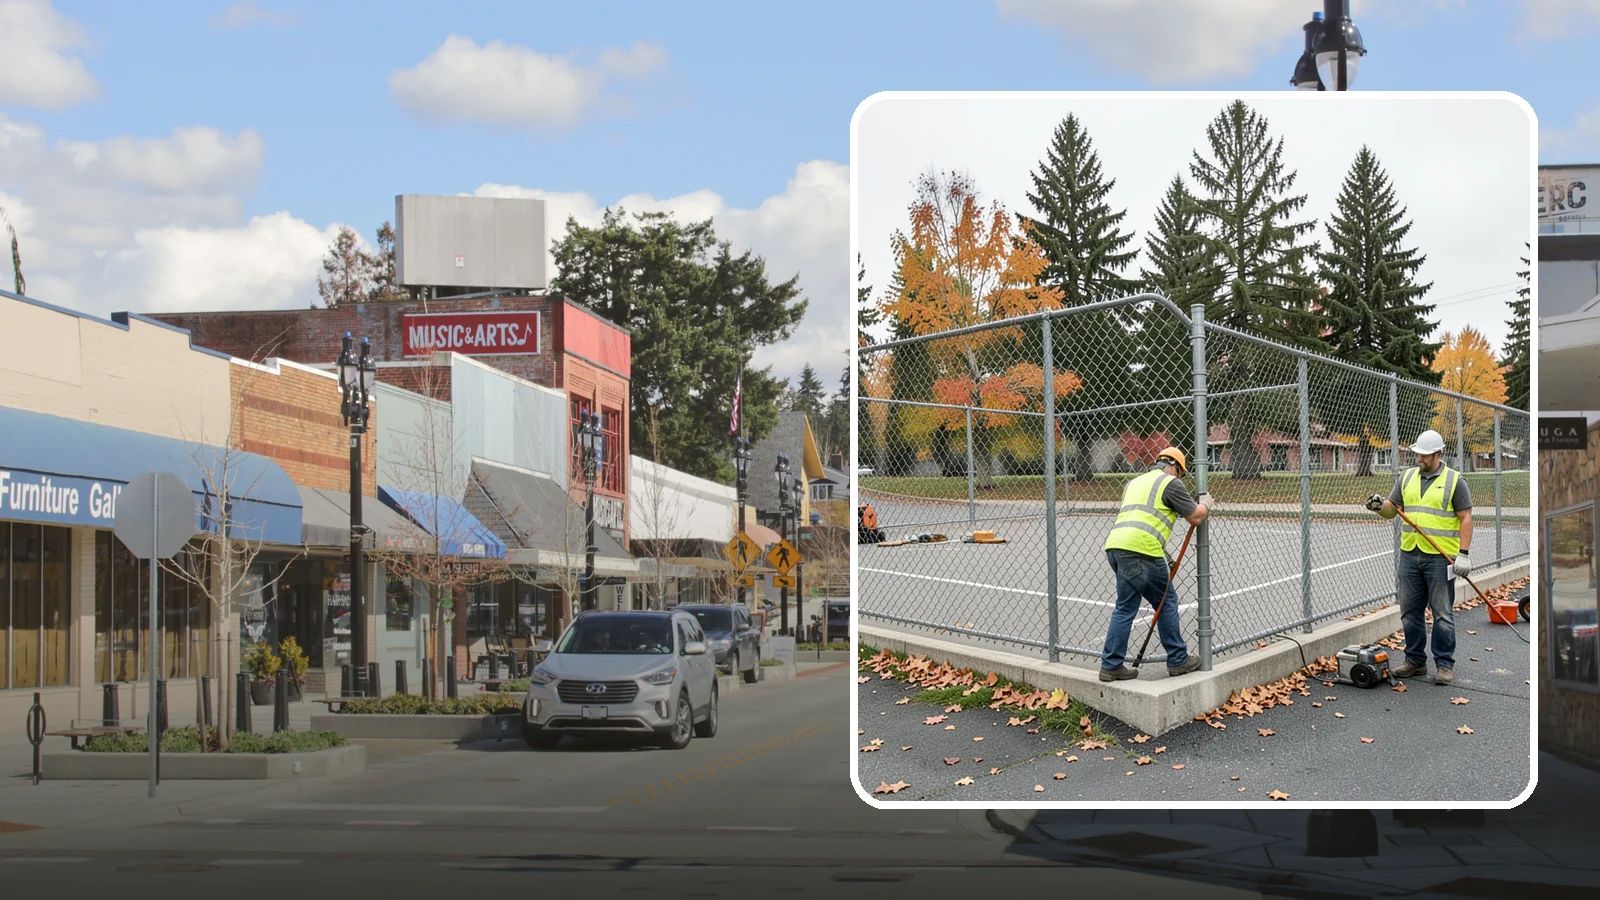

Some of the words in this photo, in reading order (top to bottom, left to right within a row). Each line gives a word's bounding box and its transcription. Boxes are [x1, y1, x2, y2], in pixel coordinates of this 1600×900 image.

[0, 471, 79, 515] Furniture
[89, 482, 122, 519] Gal
[453, 563, 479, 574] SUSHI
